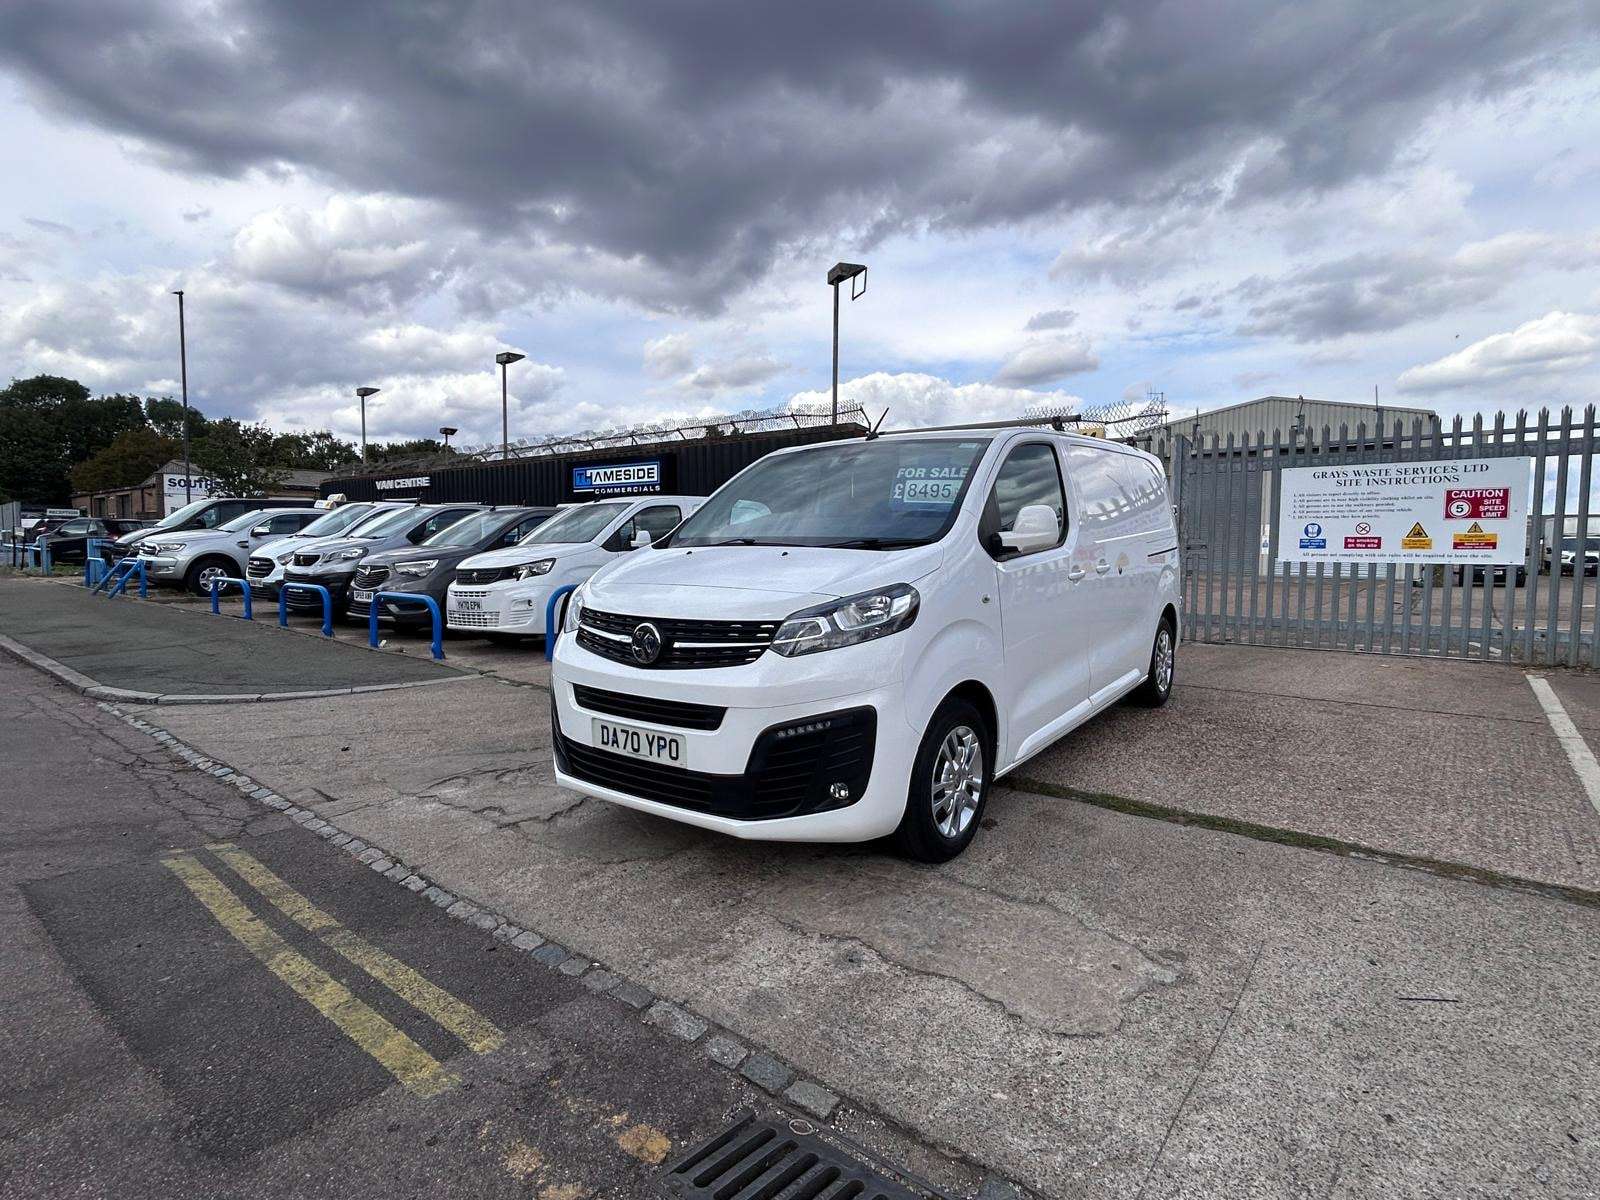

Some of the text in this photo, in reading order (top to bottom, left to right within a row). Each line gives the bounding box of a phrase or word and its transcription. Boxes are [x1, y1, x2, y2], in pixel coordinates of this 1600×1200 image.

[575, 467, 656, 486] THAMESIDE
[896, 467, 969, 478] FOR SALE
[1312, 464, 1489, 479] GRAYS WASTE SERVICES LTD
[376, 476, 430, 490] VAN CENTRE
[1367, 475, 1460, 486] INSTRUCTIONS
[594, 486, 661, 494] COMMERCIALS
[1451, 490, 1504, 498] CAUTION
[1456, 504, 1464, 513] 5
[600, 724, 640, 752] DA70
